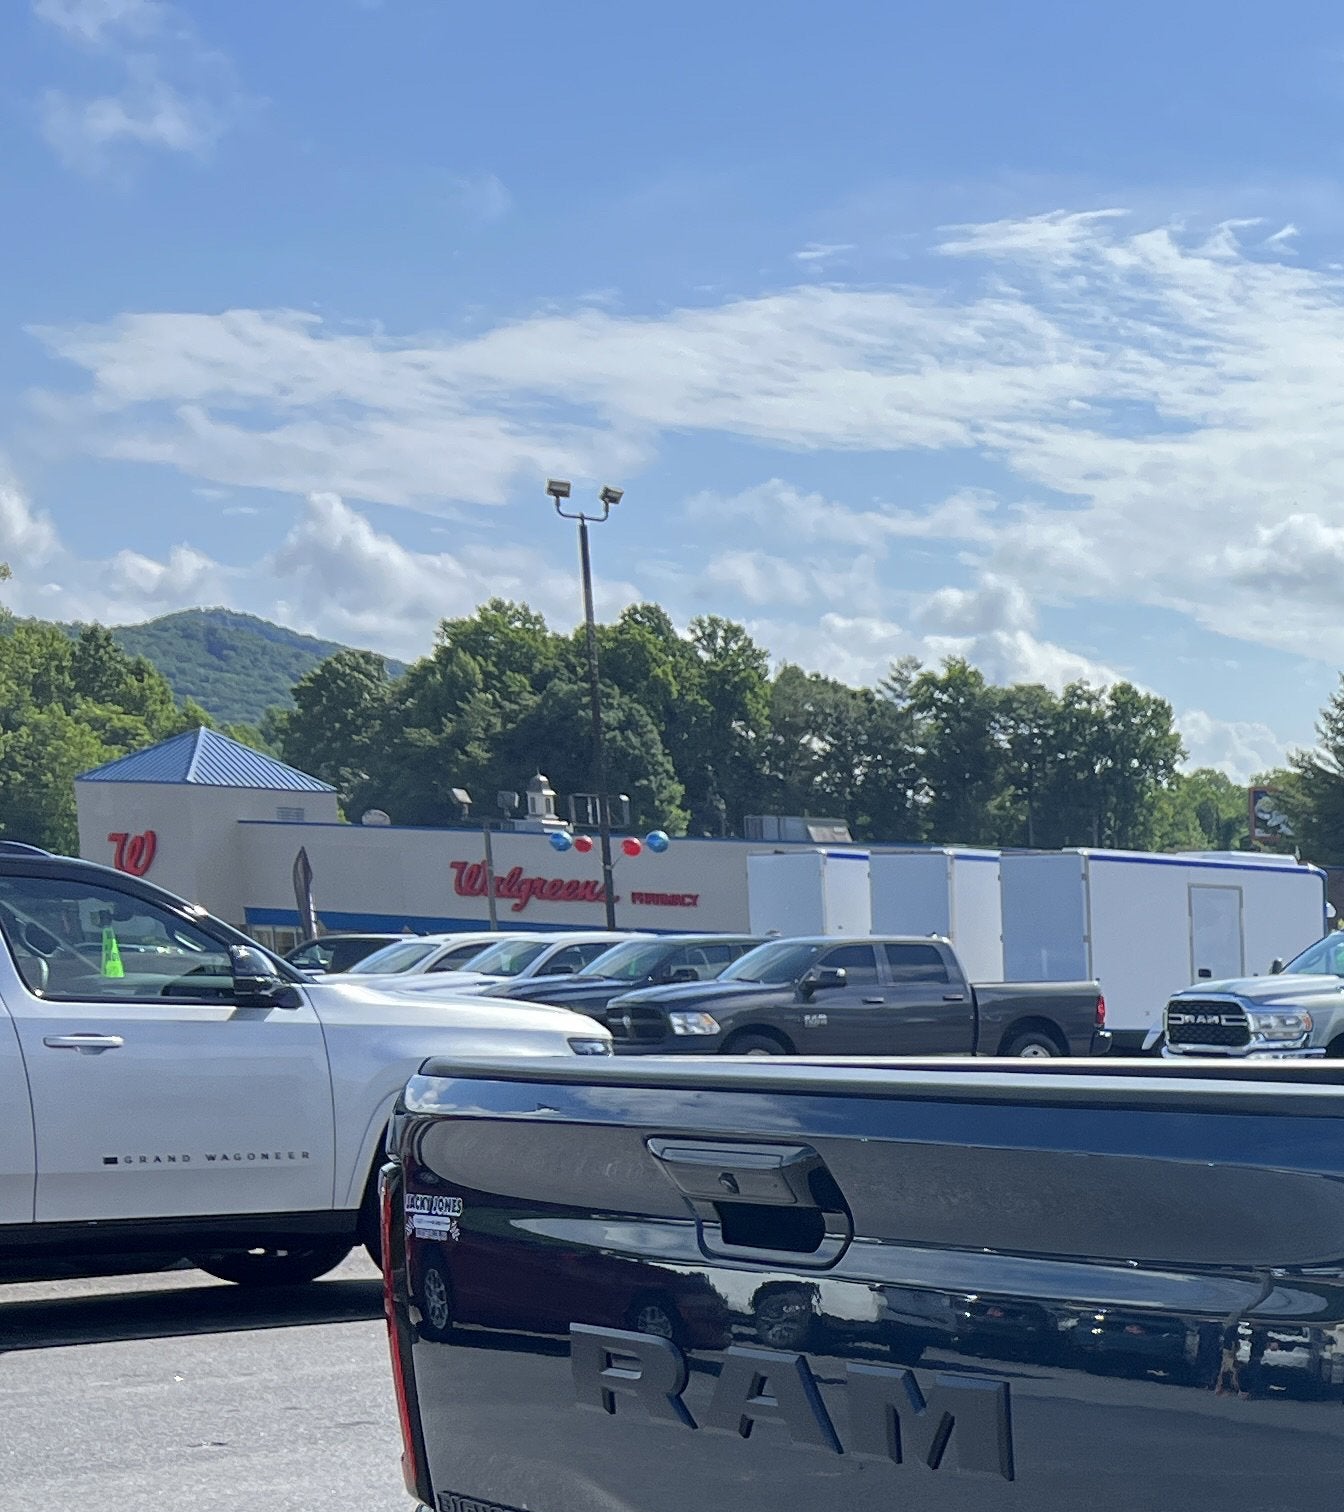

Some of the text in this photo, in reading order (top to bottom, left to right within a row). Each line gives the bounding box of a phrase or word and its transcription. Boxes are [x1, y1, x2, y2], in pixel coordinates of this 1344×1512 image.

[108, 830, 156, 877] W
[1184, 1014, 1220, 1025] RAM
[124, 1151, 310, 1165] GRAND WAGONEER
[569, 1322, 1016, 1482] RAM
